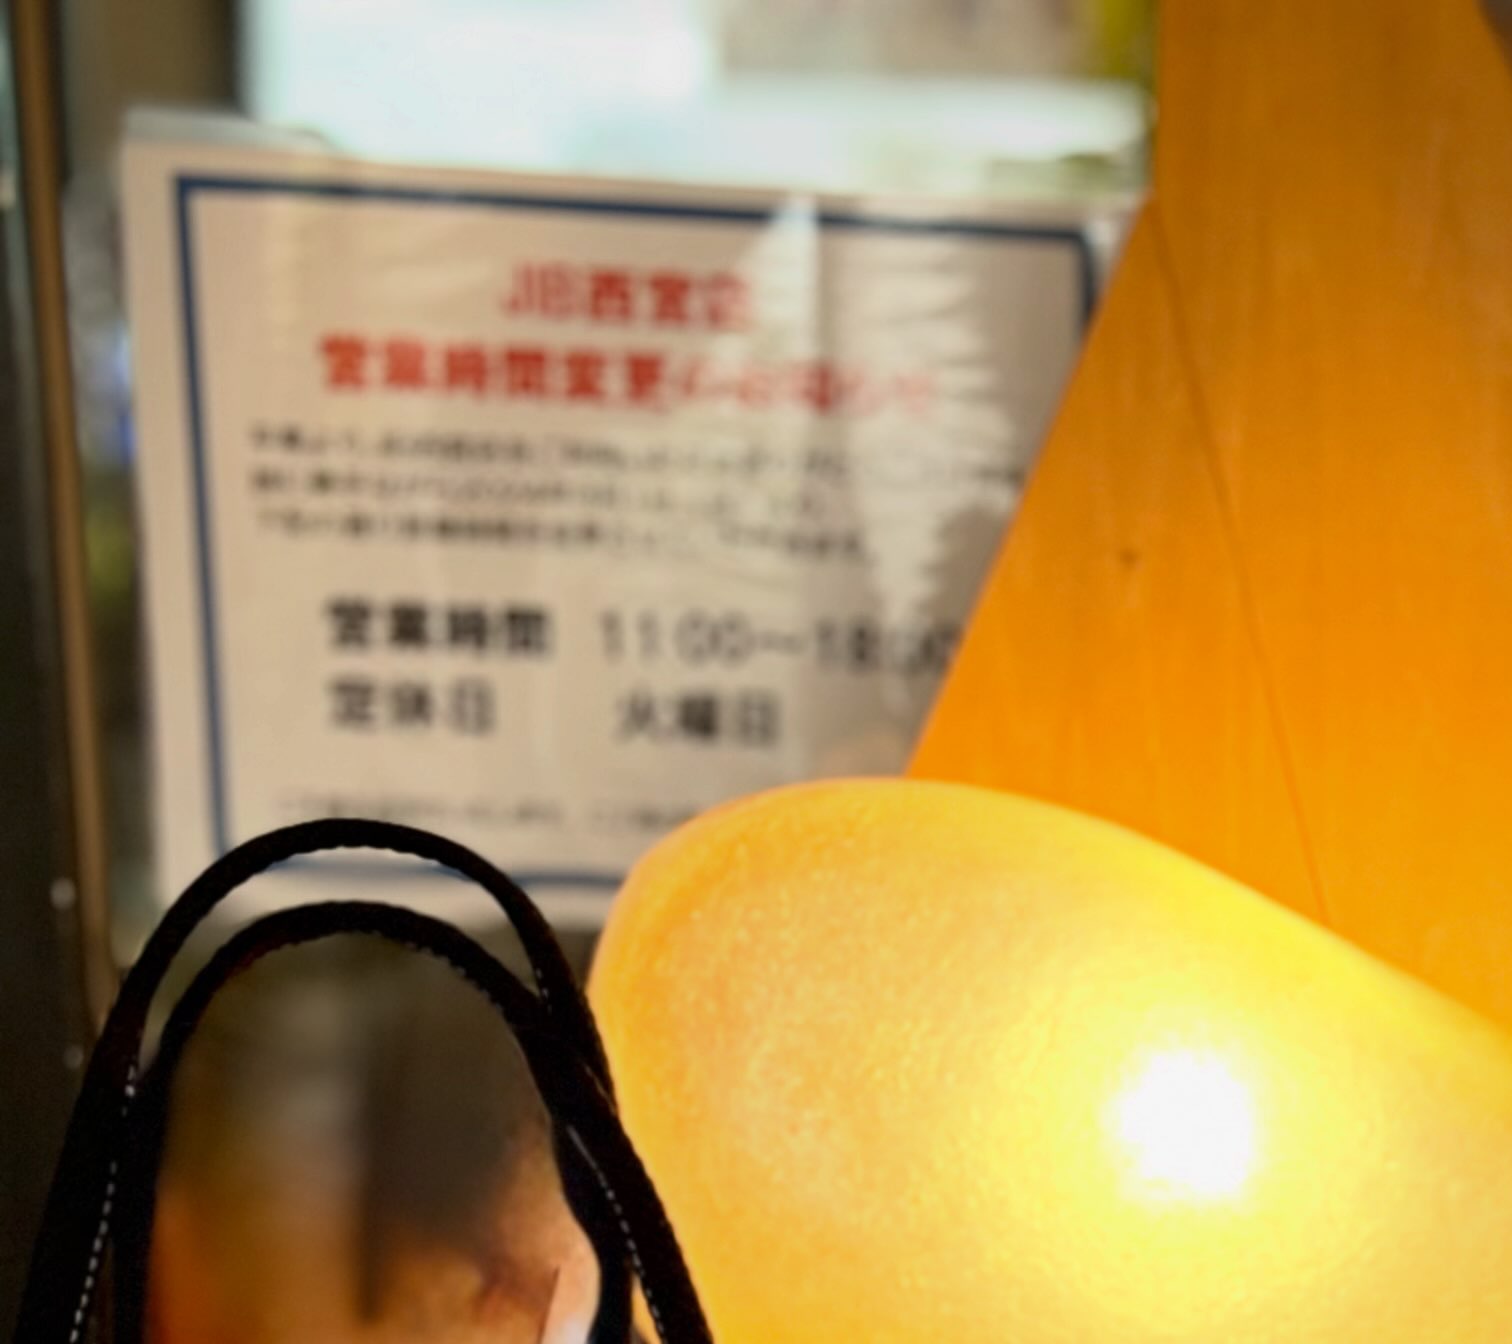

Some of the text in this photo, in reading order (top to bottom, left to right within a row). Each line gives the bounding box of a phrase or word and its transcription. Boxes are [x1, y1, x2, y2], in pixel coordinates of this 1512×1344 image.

[328, 599, 552, 658] 営業時間
[328, 676, 784, 748] 定休日 火曜日
